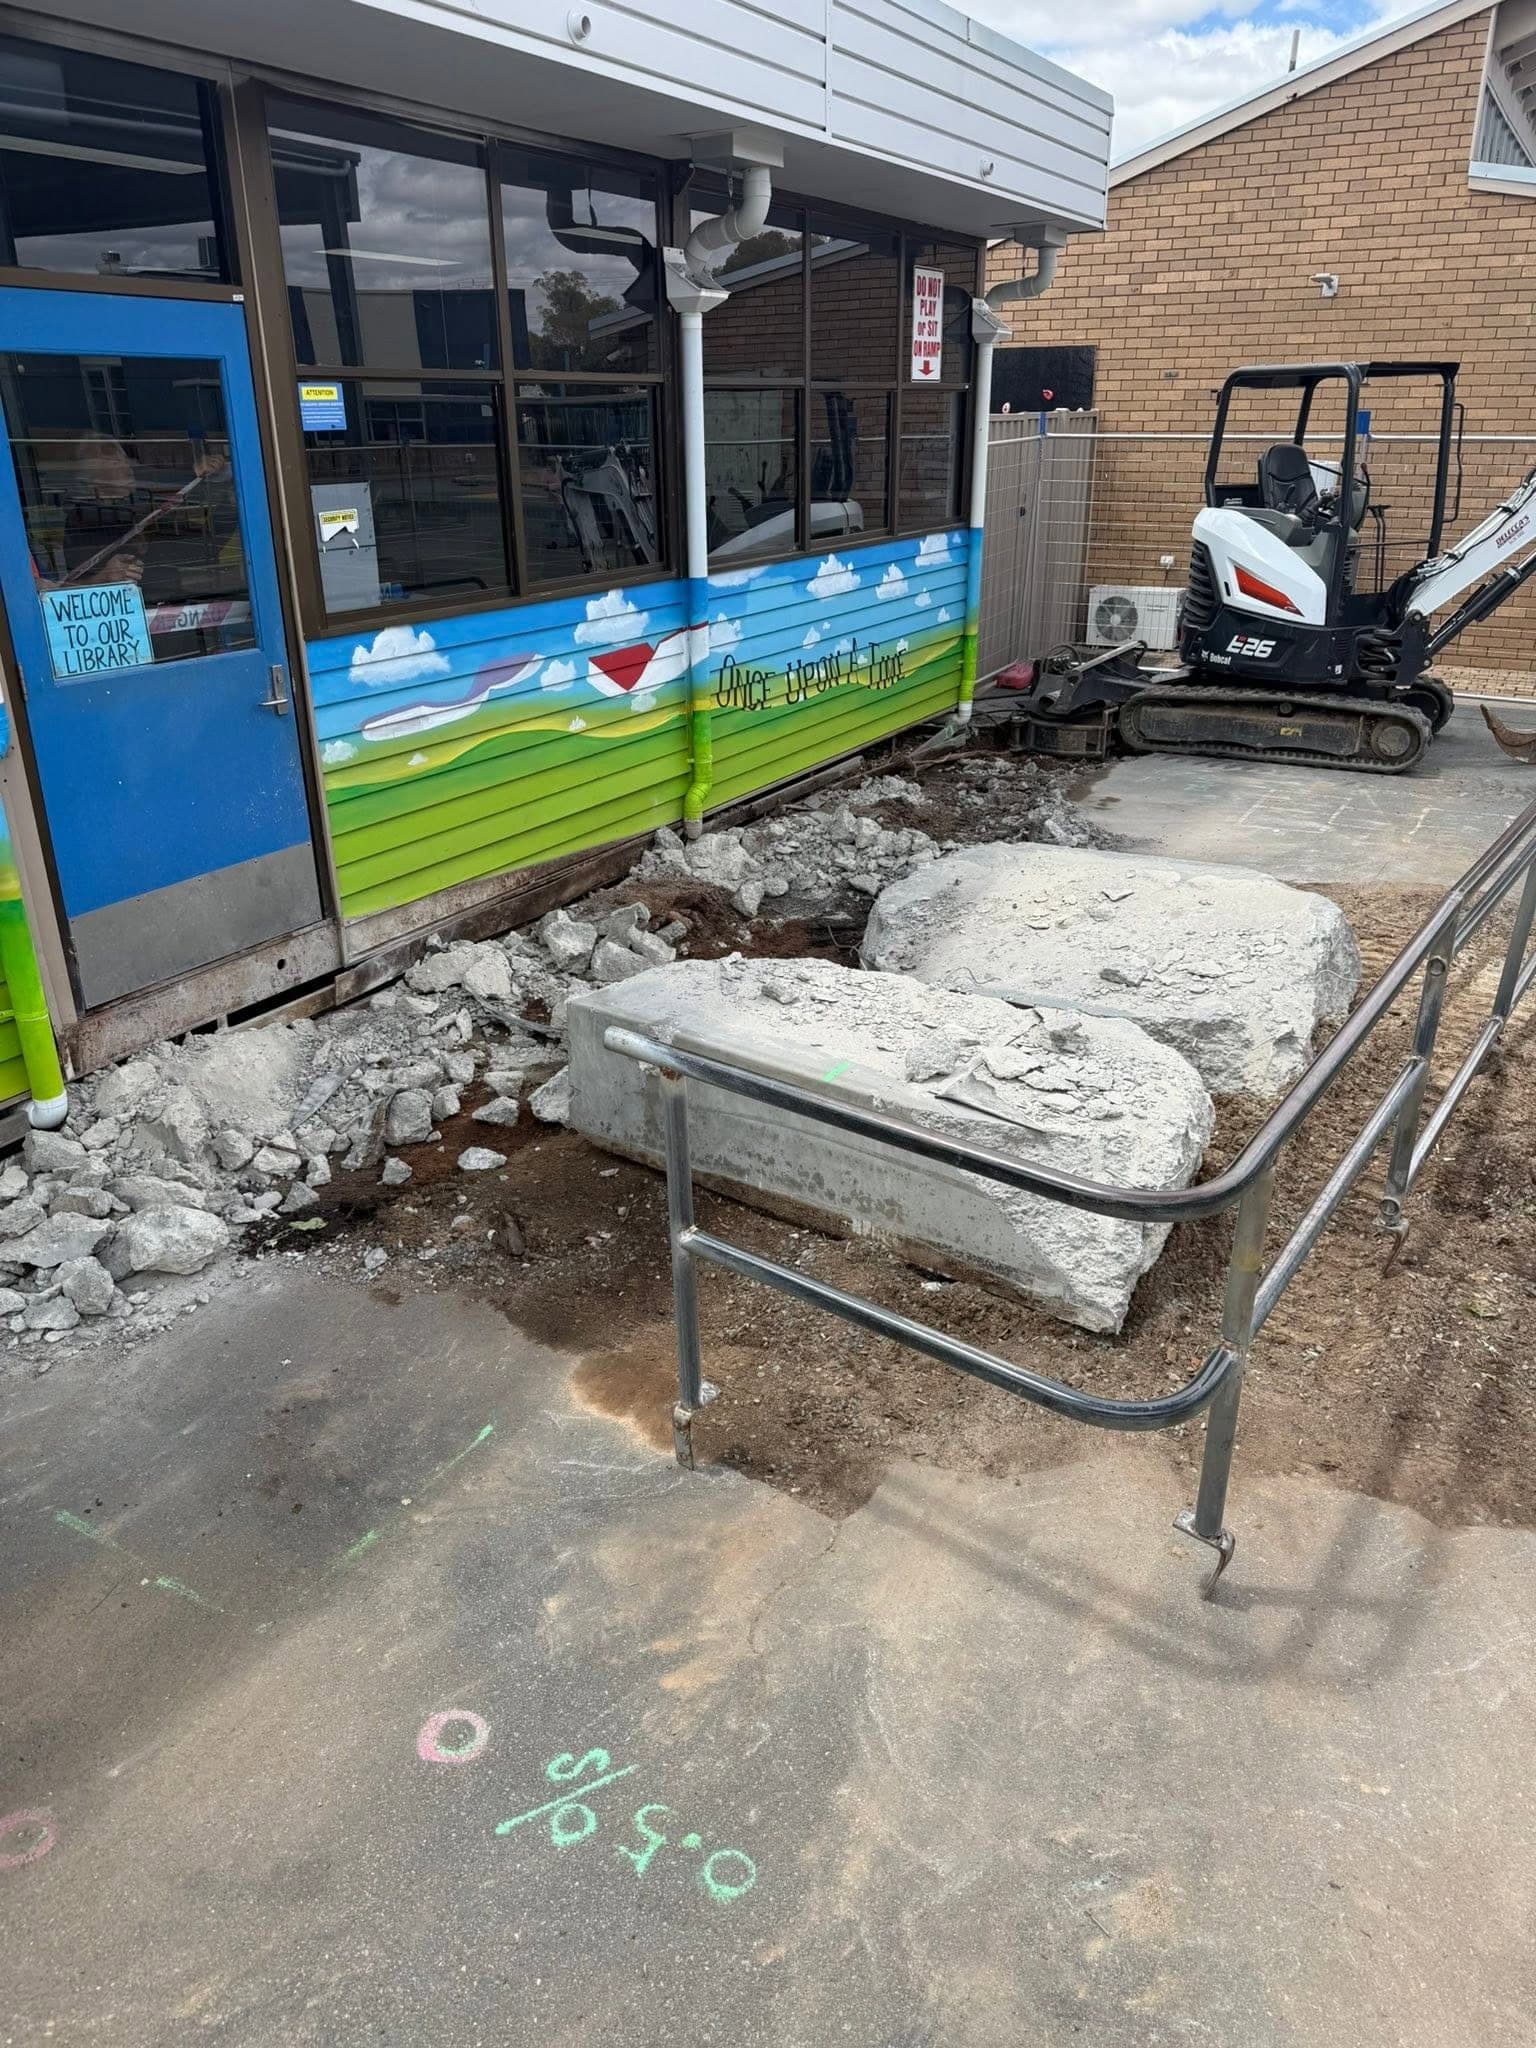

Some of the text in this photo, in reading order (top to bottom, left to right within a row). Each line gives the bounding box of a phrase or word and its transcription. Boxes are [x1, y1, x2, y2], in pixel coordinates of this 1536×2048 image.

[916, 275, 941, 298] DO NOT
[919, 299, 937, 317] PLAY
[927, 319, 938, 337] SIT
[913, 340, 941, 357] ON RAMP
[306, 389, 334, 397] ATTENTION
[50, 588, 135, 622] WELCOME
[63, 618, 133, 647] TO OUR
[63, 640, 141, 674] LIBRARY
[1225, 634, 1277, 658] E26
[847, 637, 859, 684] A
[1209, 652, 1232, 666] Bobcat
